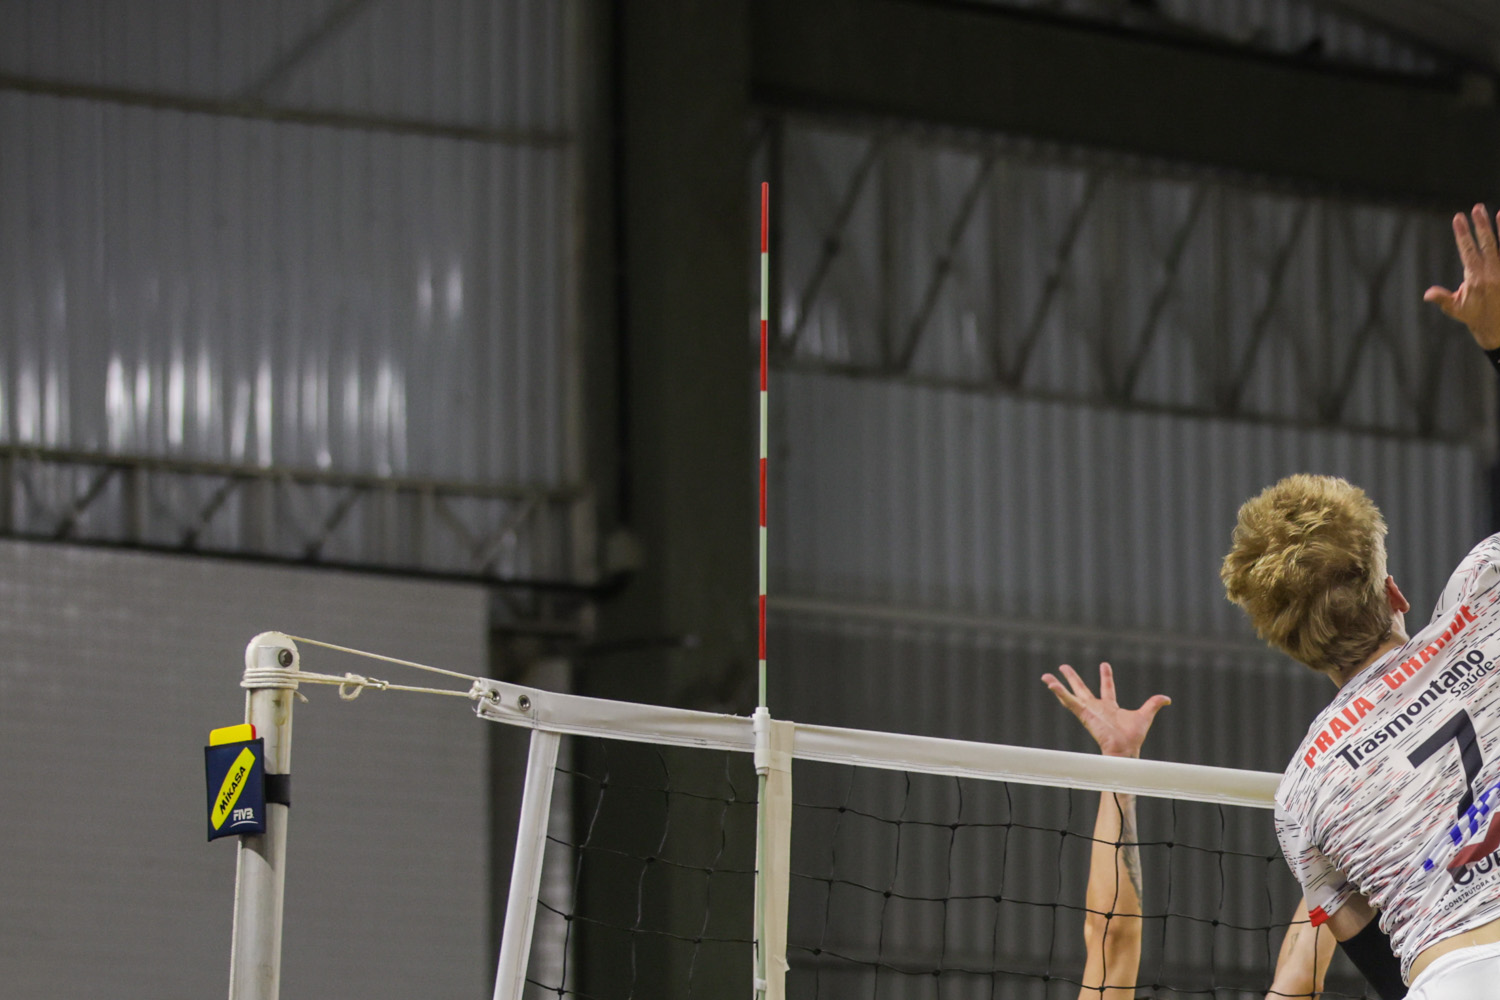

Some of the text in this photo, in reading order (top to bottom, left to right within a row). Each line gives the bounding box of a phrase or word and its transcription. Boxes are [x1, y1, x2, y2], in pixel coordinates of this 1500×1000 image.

[1450, 660, 1496, 698] Saúde
[1303, 696, 1375, 769] PRAIA
[1334, 649, 1485, 770] Trasmontano
[1406, 708, 1484, 821] 7
[219, 766, 247, 815] MIKASA
[233, 808, 254, 821] FIVB
[1444, 879, 1490, 911] CONSTRUTORA
